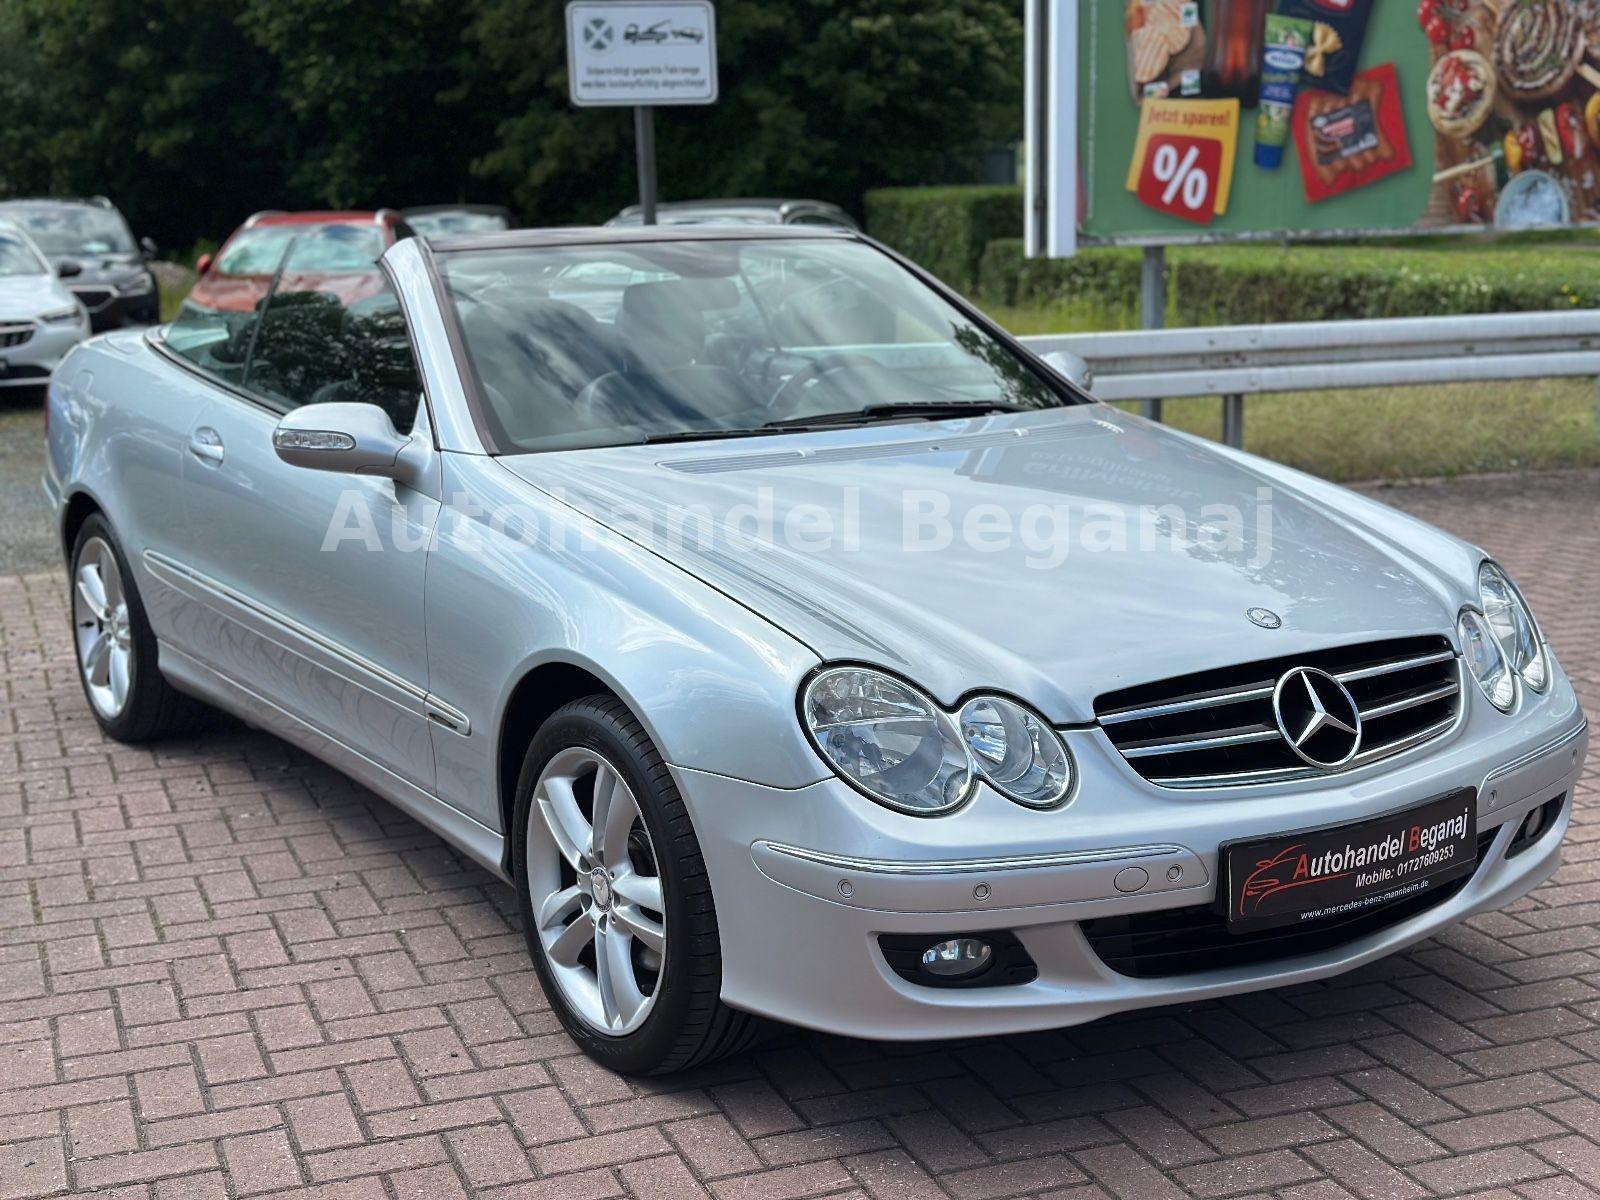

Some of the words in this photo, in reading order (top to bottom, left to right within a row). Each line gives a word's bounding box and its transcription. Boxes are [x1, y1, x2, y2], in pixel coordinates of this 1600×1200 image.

[1148, 107, 1179, 124] Jetzt
[1182, 109, 1231, 128] sparen!
[1153, 144, 1208, 210] %
[1293, 831, 1405, 880] Autohandel
[1409, 808, 1469, 852] Beganaj
[1356, 869, 1394, 889] Mobile:
[1397, 845, 1454, 877] 01727609253
[1301, 879, 1429, 920] www.mercedes-benz-mannheim.de
